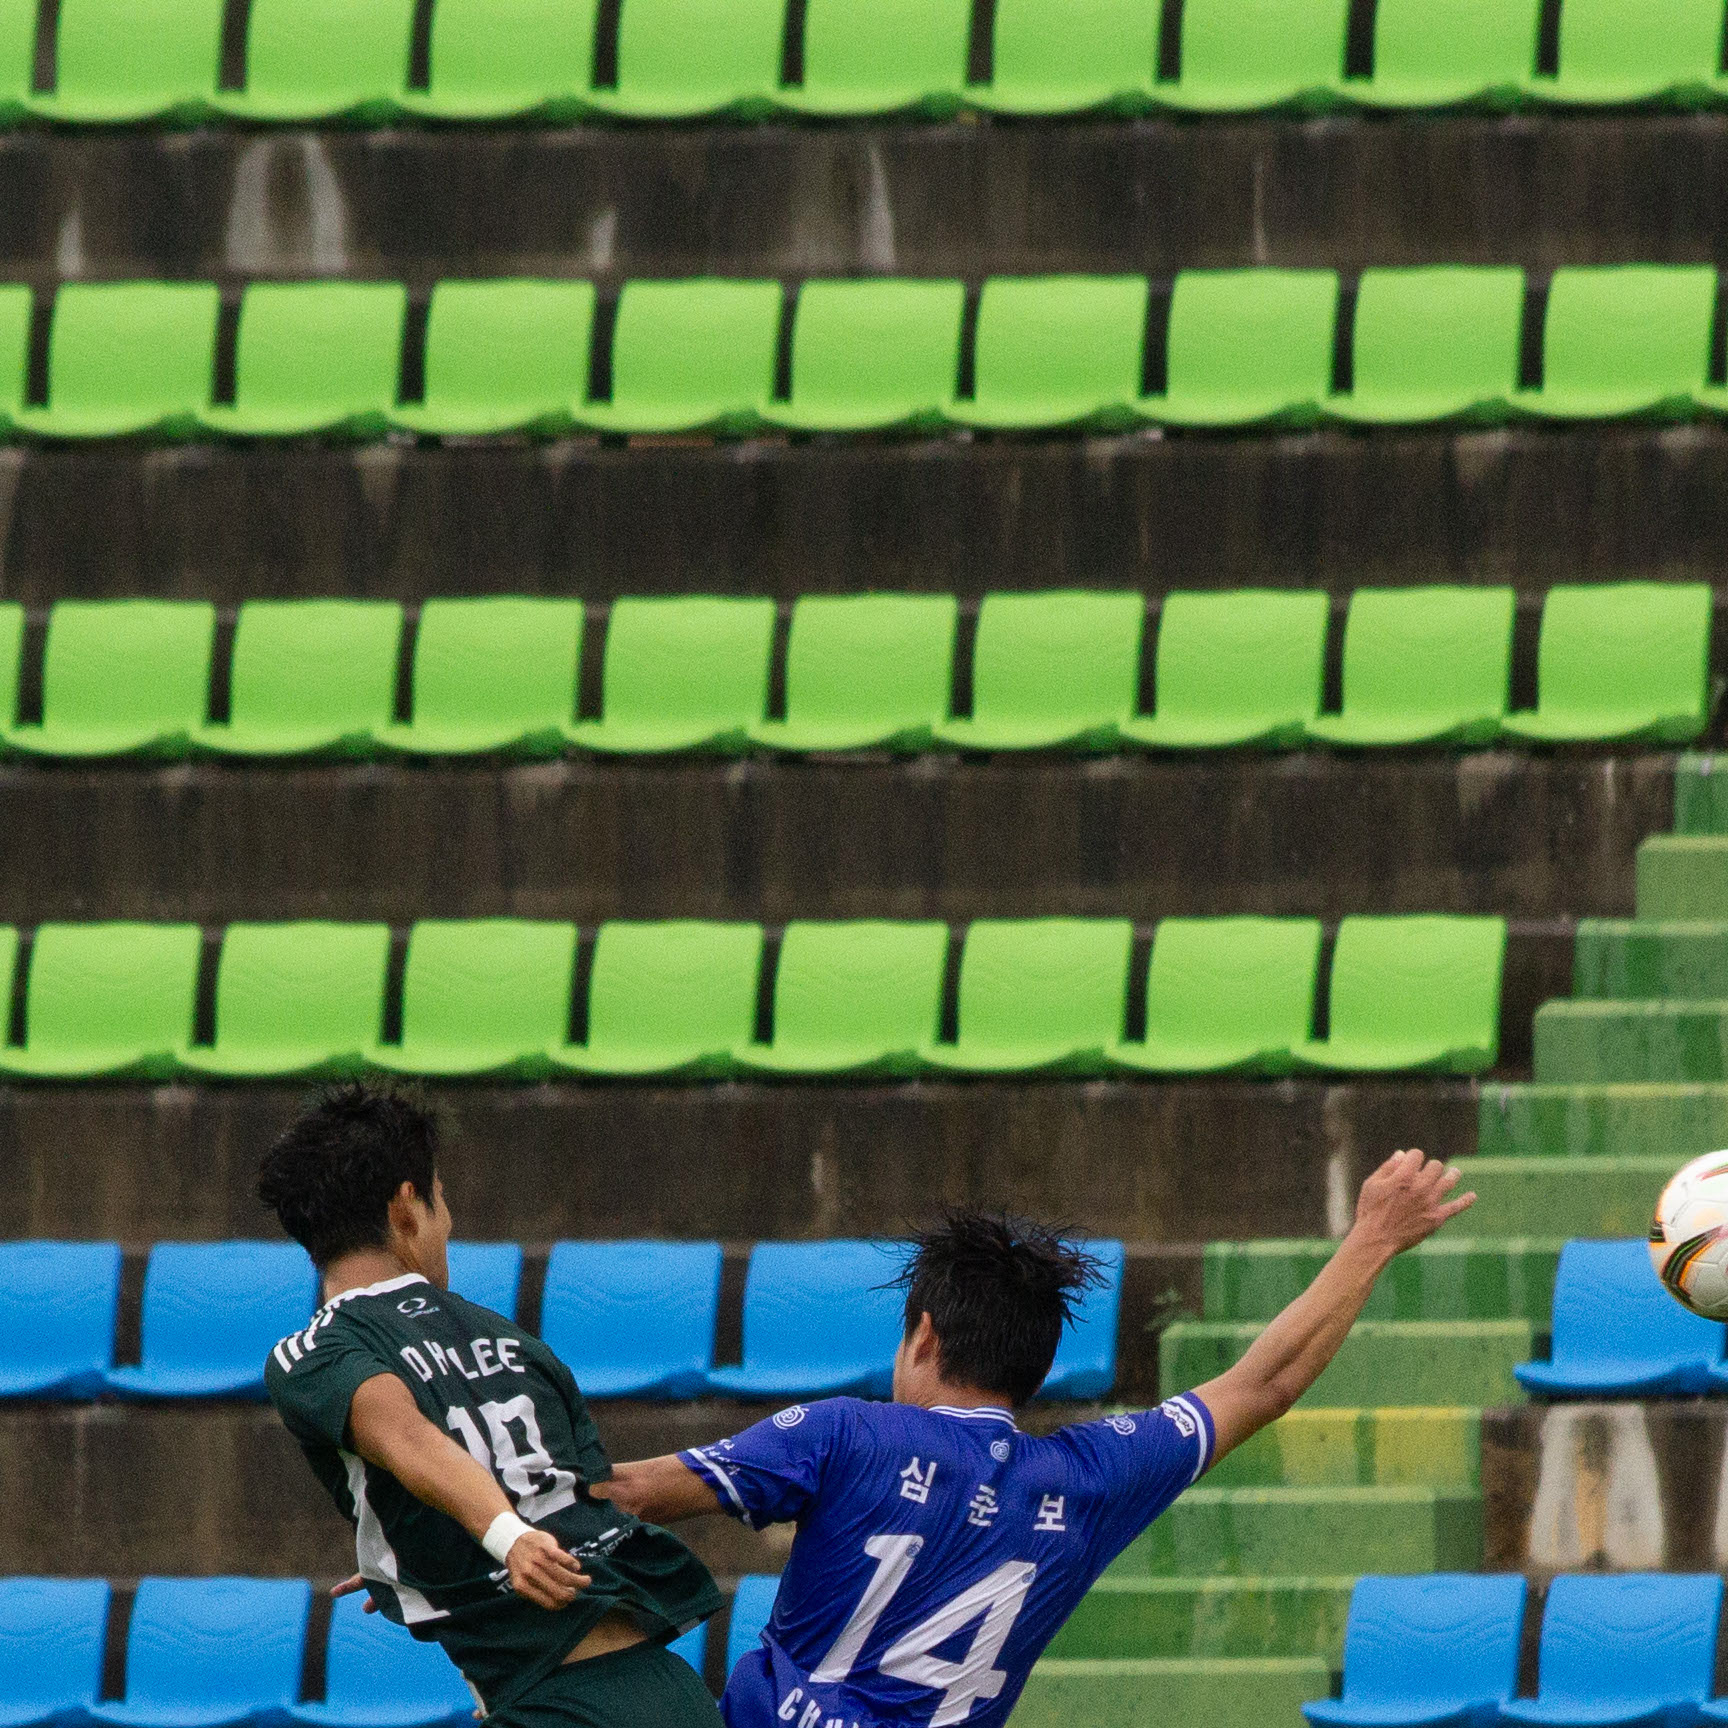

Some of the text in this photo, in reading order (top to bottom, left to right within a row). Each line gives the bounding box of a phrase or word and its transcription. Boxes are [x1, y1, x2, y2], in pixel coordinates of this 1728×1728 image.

[445, 1337, 526, 1380] LEE
[445, 1394, 577, 1523] 18
[808, 1533, 1038, 1728] 14
